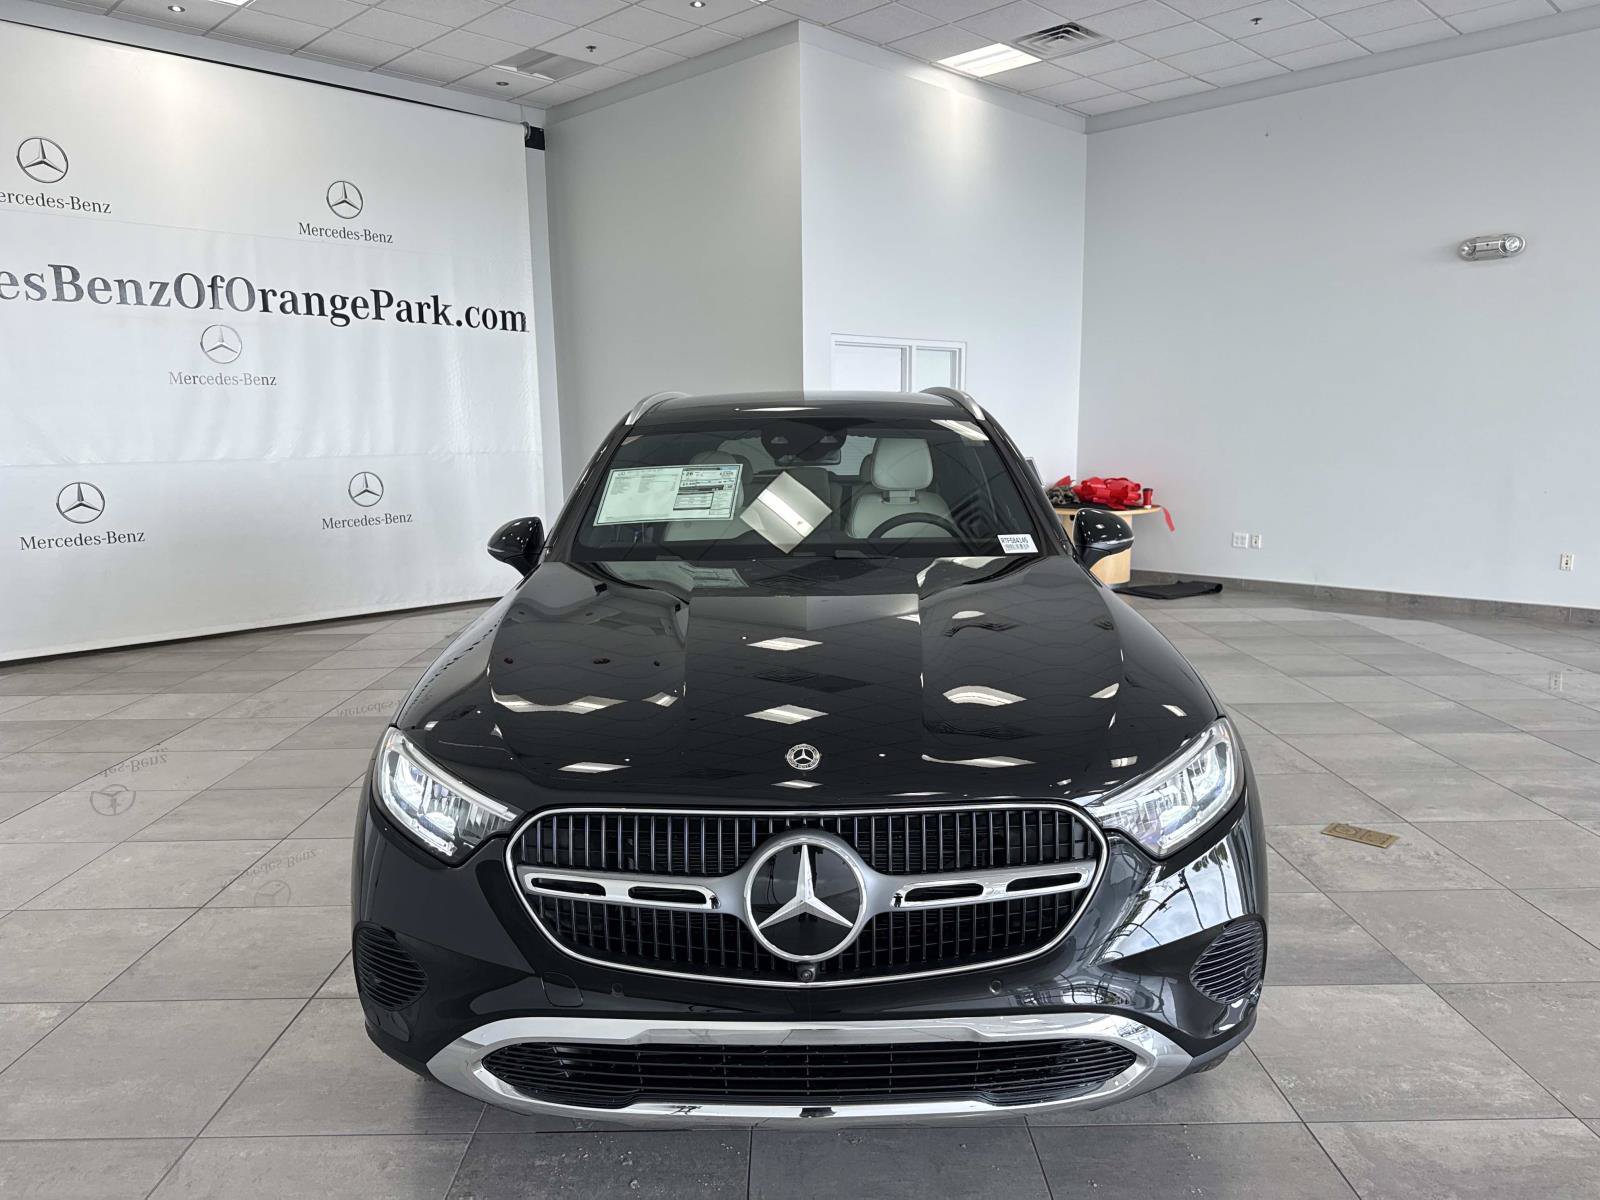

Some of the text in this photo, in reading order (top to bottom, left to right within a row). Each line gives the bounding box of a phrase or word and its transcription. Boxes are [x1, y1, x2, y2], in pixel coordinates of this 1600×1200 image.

[298, 222, 393, 244] Mercedes-Benz
[0, 263, 528, 333] esBenzOfOrangePark.com
[168, 371, 277, 386] Mercedes-Benz
[321, 511, 413, 531] Mercedes-Benz
[19, 530, 146, 551] Mercedes-Benz
